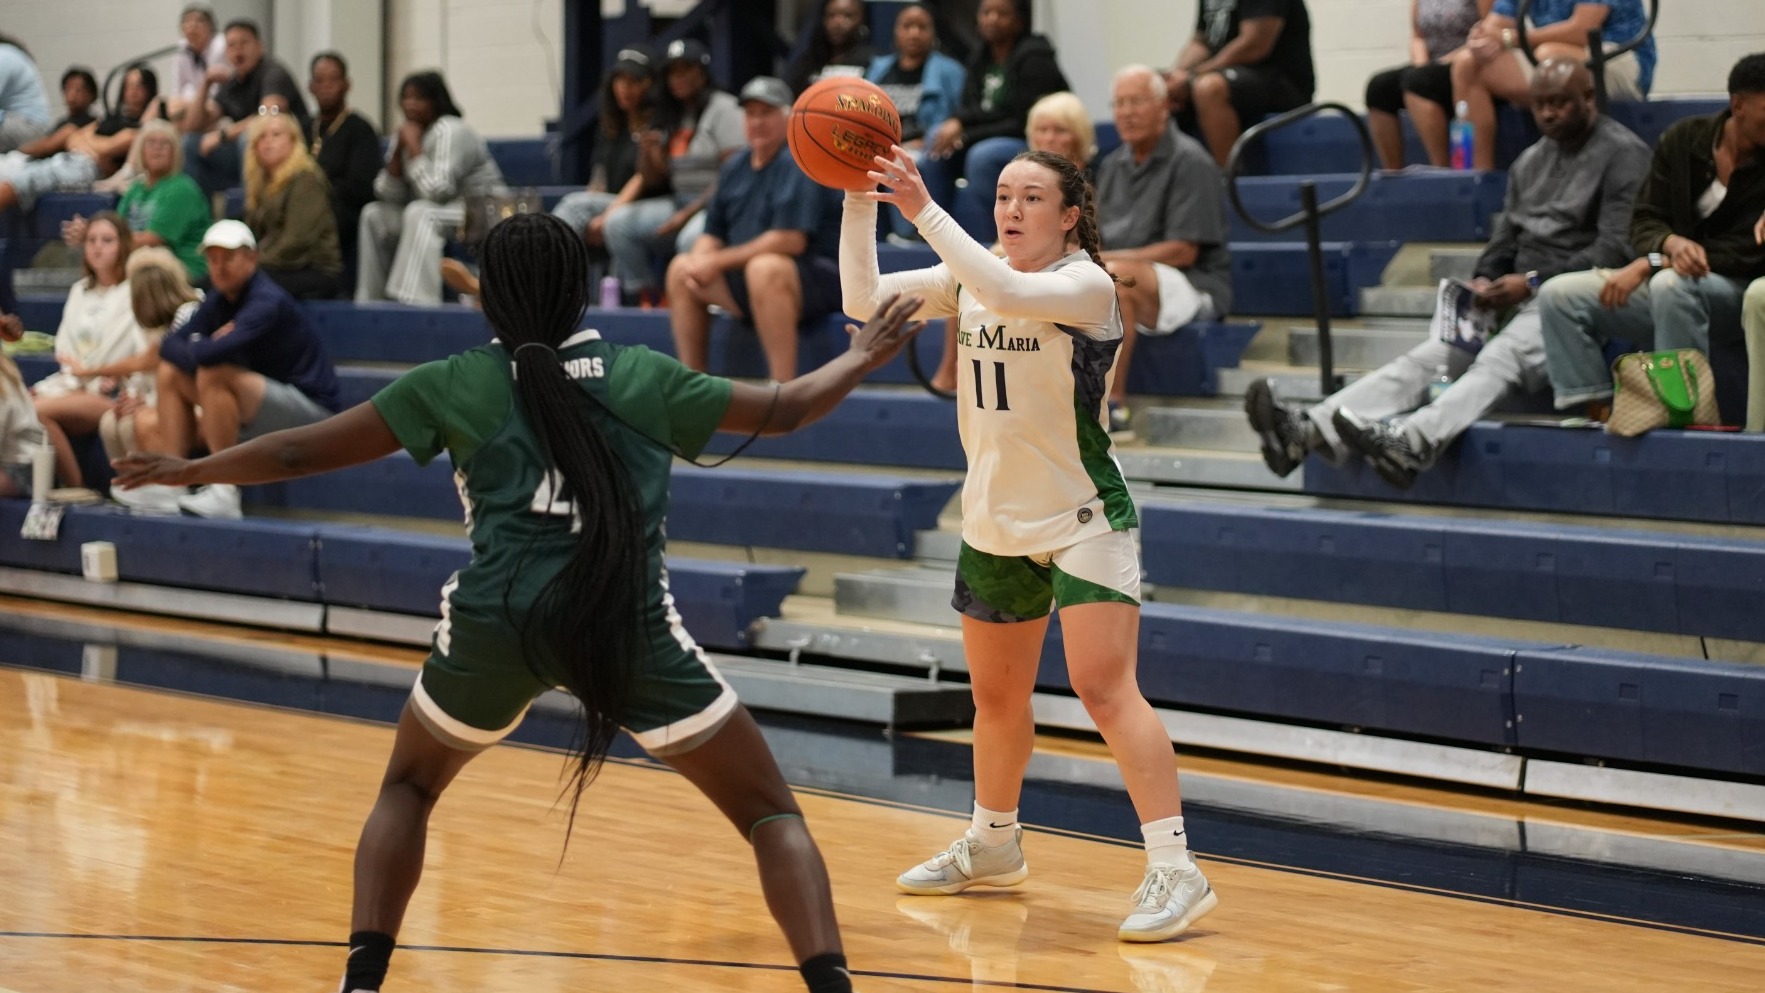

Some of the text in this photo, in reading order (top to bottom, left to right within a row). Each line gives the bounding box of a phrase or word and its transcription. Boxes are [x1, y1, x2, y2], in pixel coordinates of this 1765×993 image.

[831, 122, 892, 154] LEGACY
[976, 324, 1041, 352] MARIA
[971, 358, 1011, 411] 11
